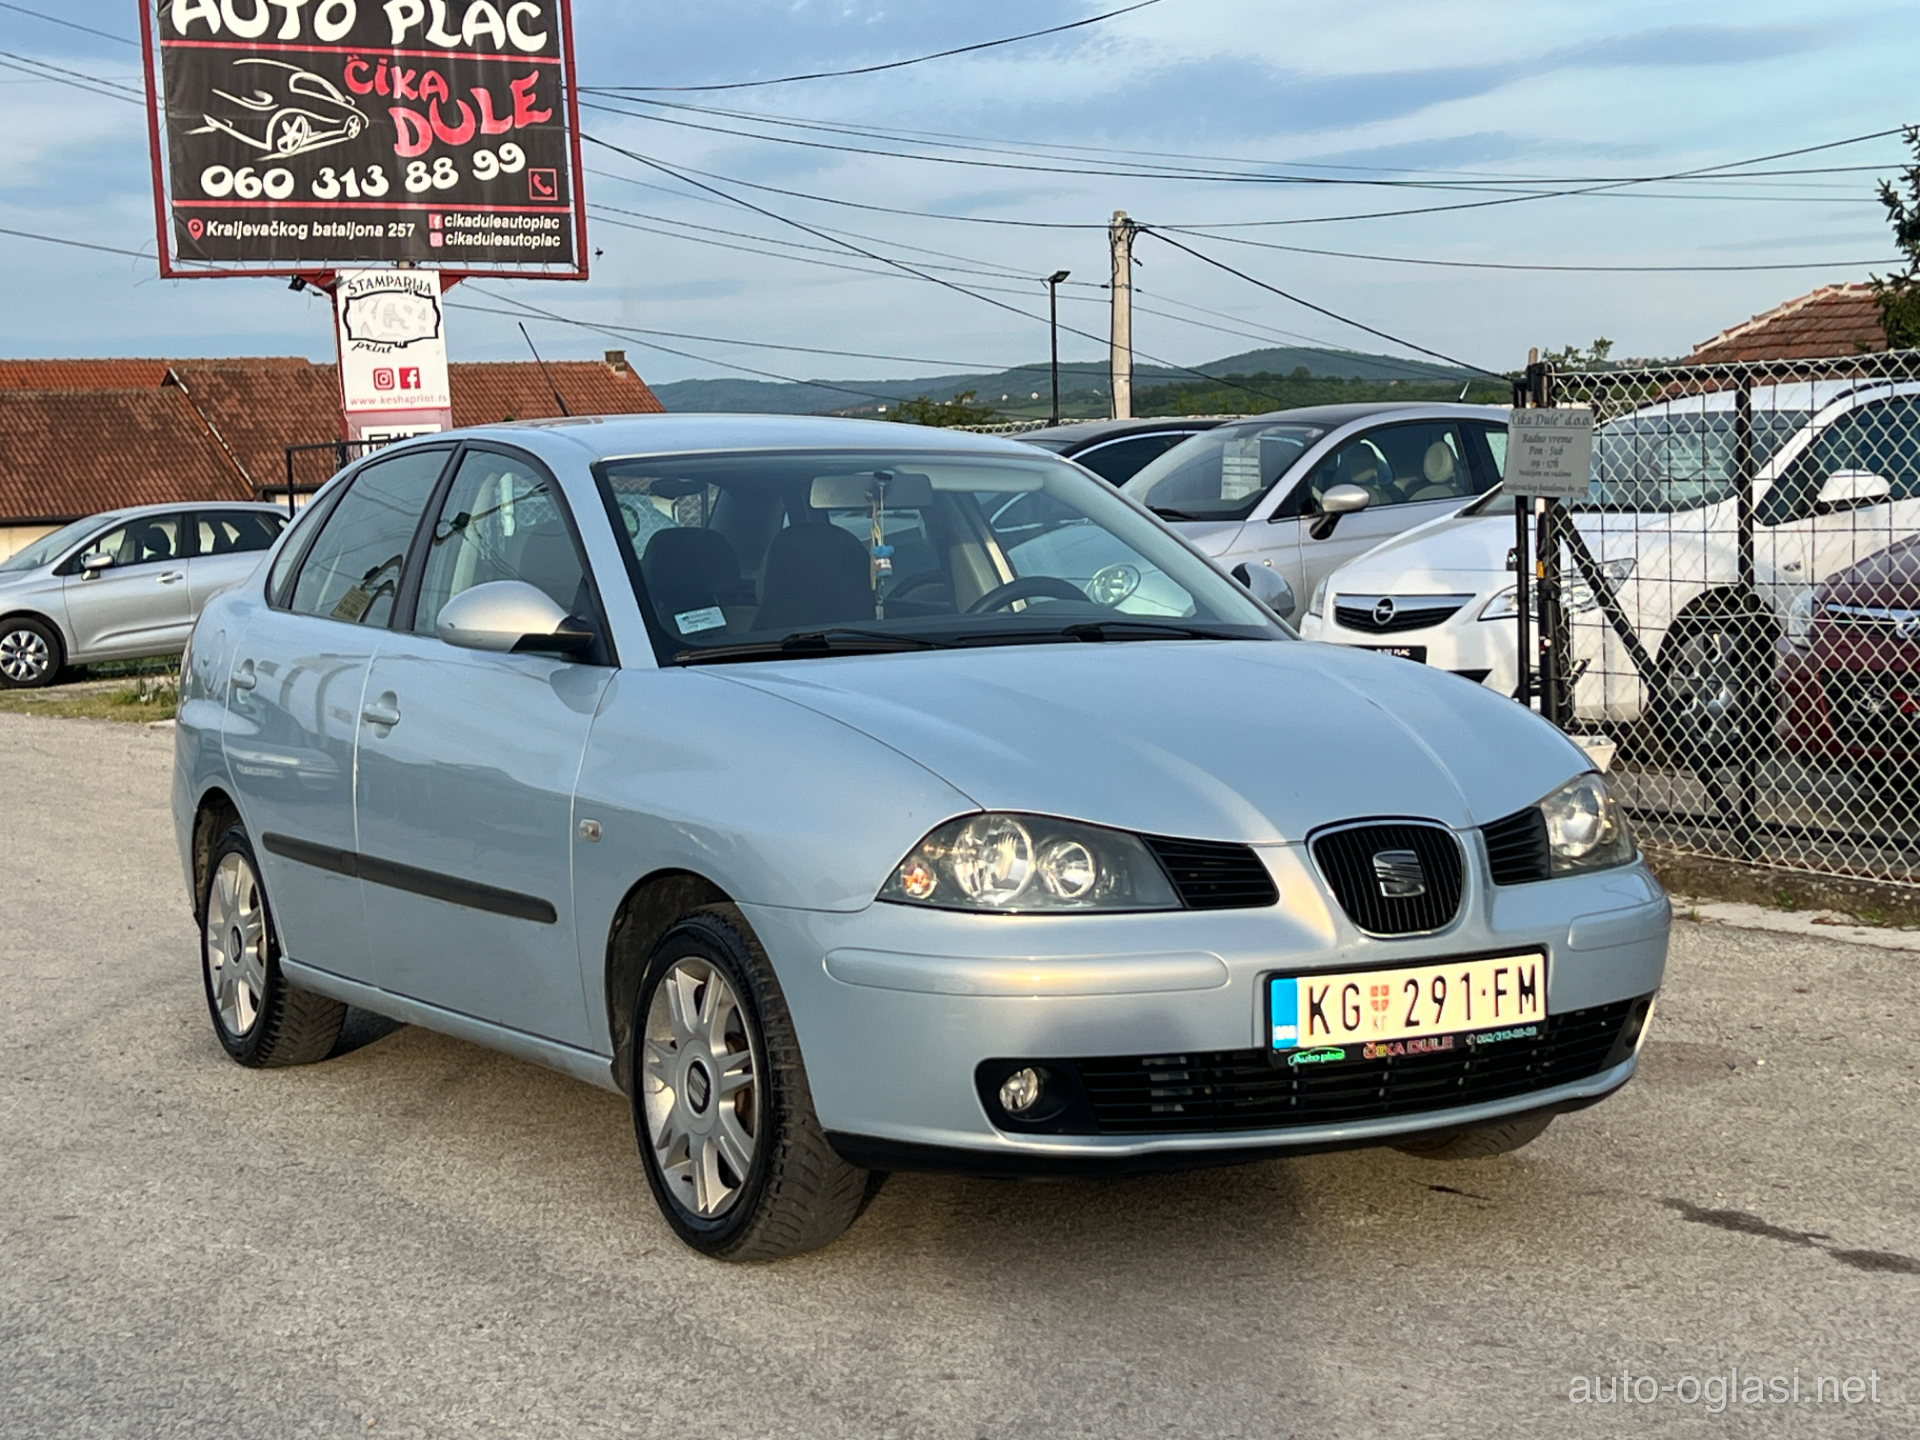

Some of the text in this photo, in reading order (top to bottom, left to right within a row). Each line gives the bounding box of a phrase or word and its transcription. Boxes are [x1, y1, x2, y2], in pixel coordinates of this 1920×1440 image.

[171, 0, 548, 52] AUTO PLAC
[388, 69, 553, 158] DULE
[200, 142, 526, 199] 060 313 88 99
[206, 219, 415, 240] Kraljevačkog bataljona 257
[351, 341, 392, 354] print
[1308, 982, 1361, 1036] KG
